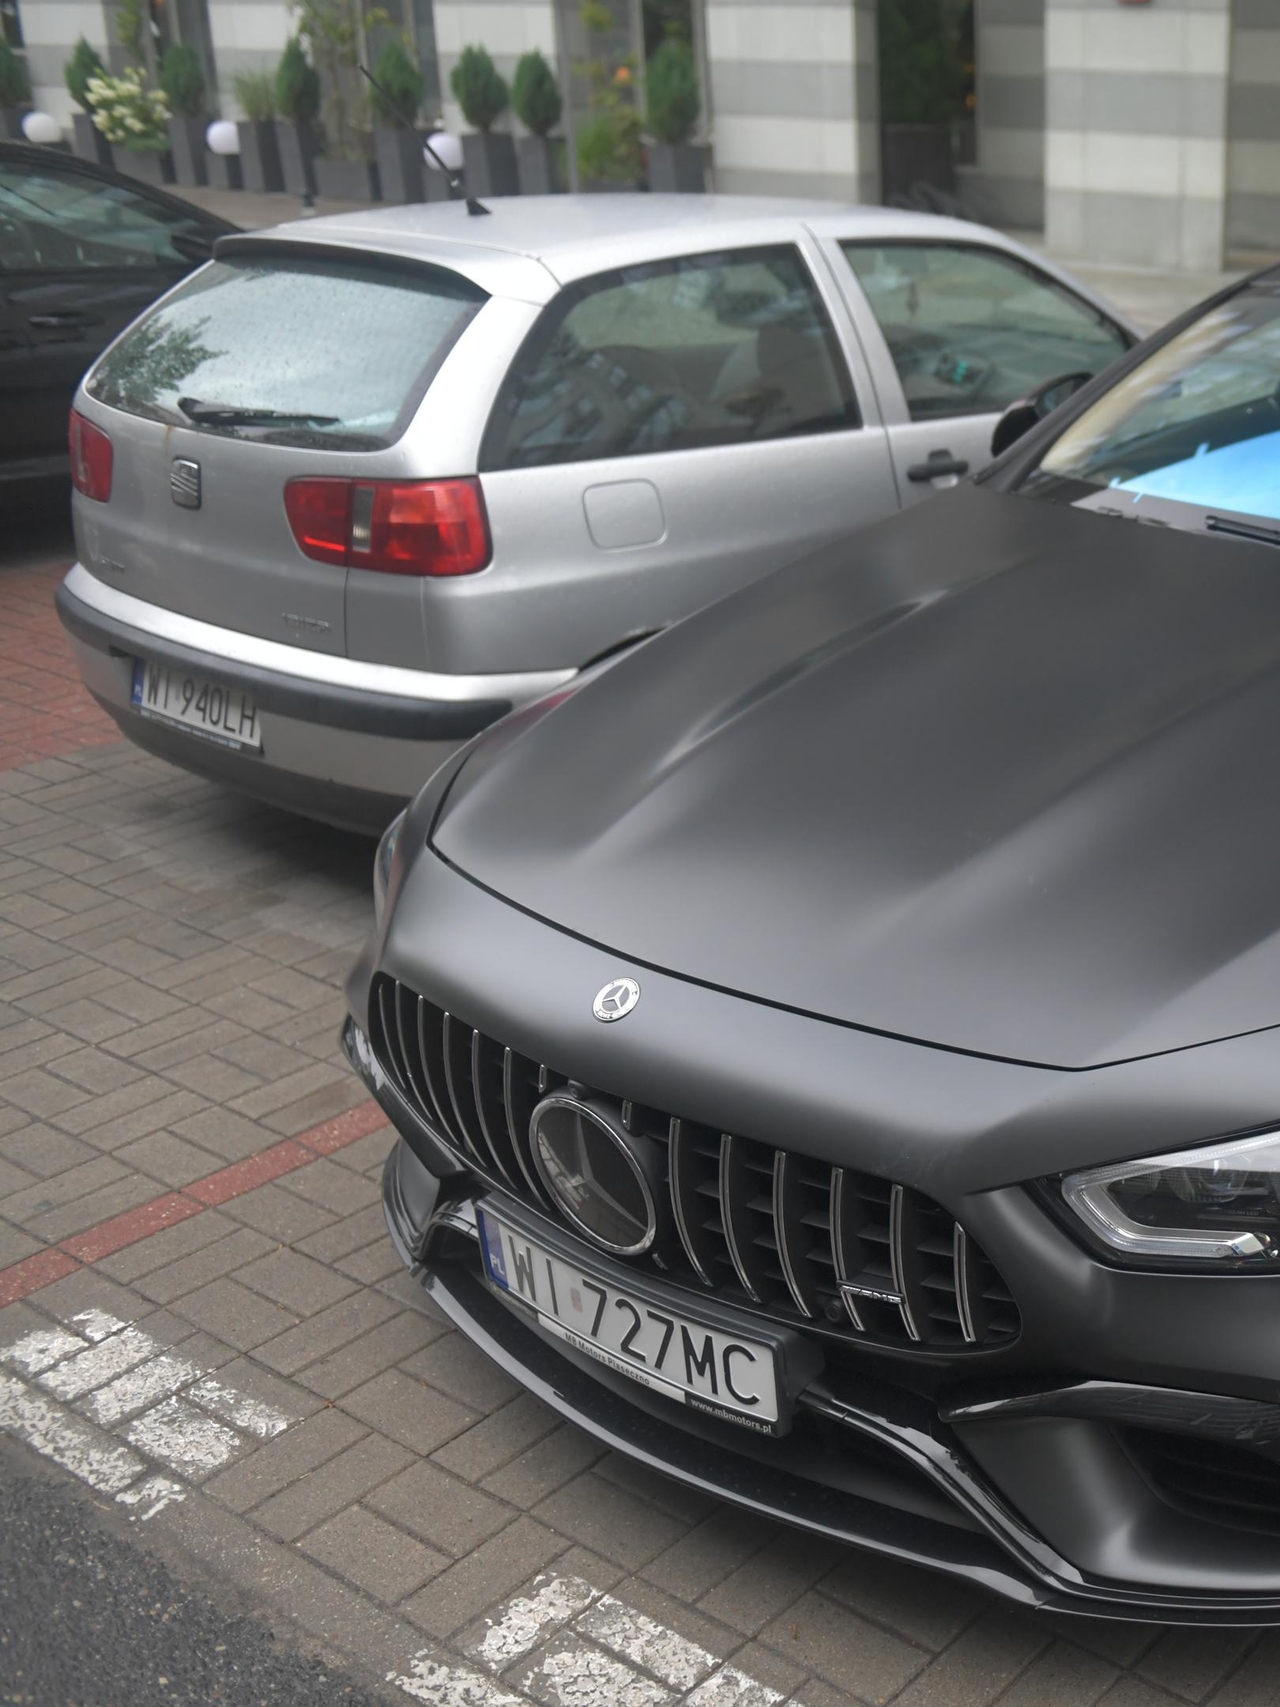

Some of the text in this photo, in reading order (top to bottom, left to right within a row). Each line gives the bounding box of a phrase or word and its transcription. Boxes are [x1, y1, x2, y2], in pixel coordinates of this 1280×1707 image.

[147, 665, 170, 710] WI
[181, 677, 257, 739] 940LH
[489, 1254, 505, 1275] PL
[508, 1234, 760, 1406] WI 727MC
[564, 1332, 650, 1385] MB Motors Piaseczno
[690, 1399, 772, 1434] www.mbmotors.pl
